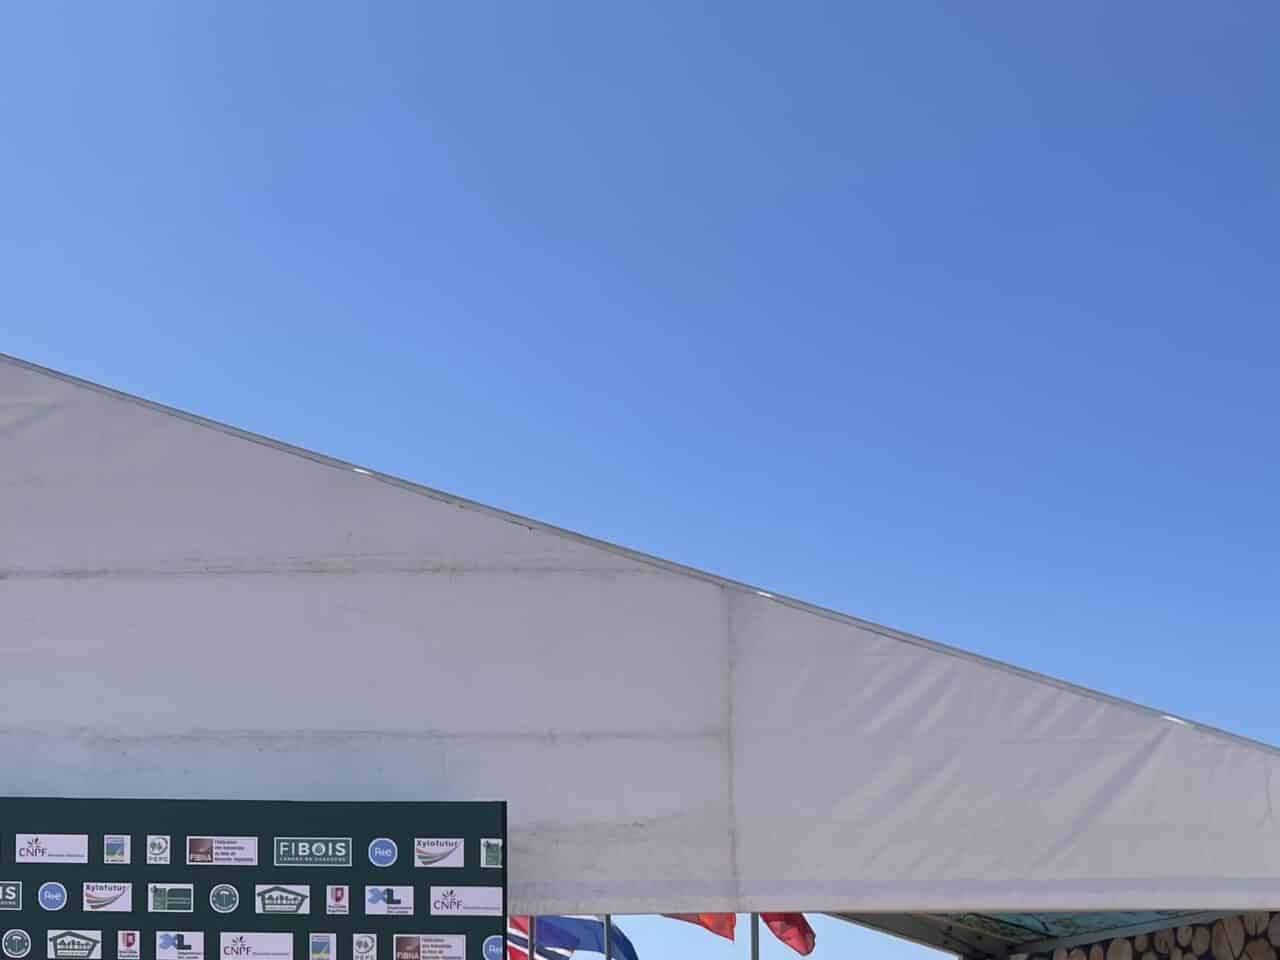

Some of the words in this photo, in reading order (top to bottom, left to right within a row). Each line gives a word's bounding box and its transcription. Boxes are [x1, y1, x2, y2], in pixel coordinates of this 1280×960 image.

[19, 848, 48, 857] CNPF
[280, 842, 346, 856] FIBOIS
[85, 884, 126, 892] Xylofutur
[434, 900, 463, 909] CNPF
[223, 946, 252, 955] CNPF
